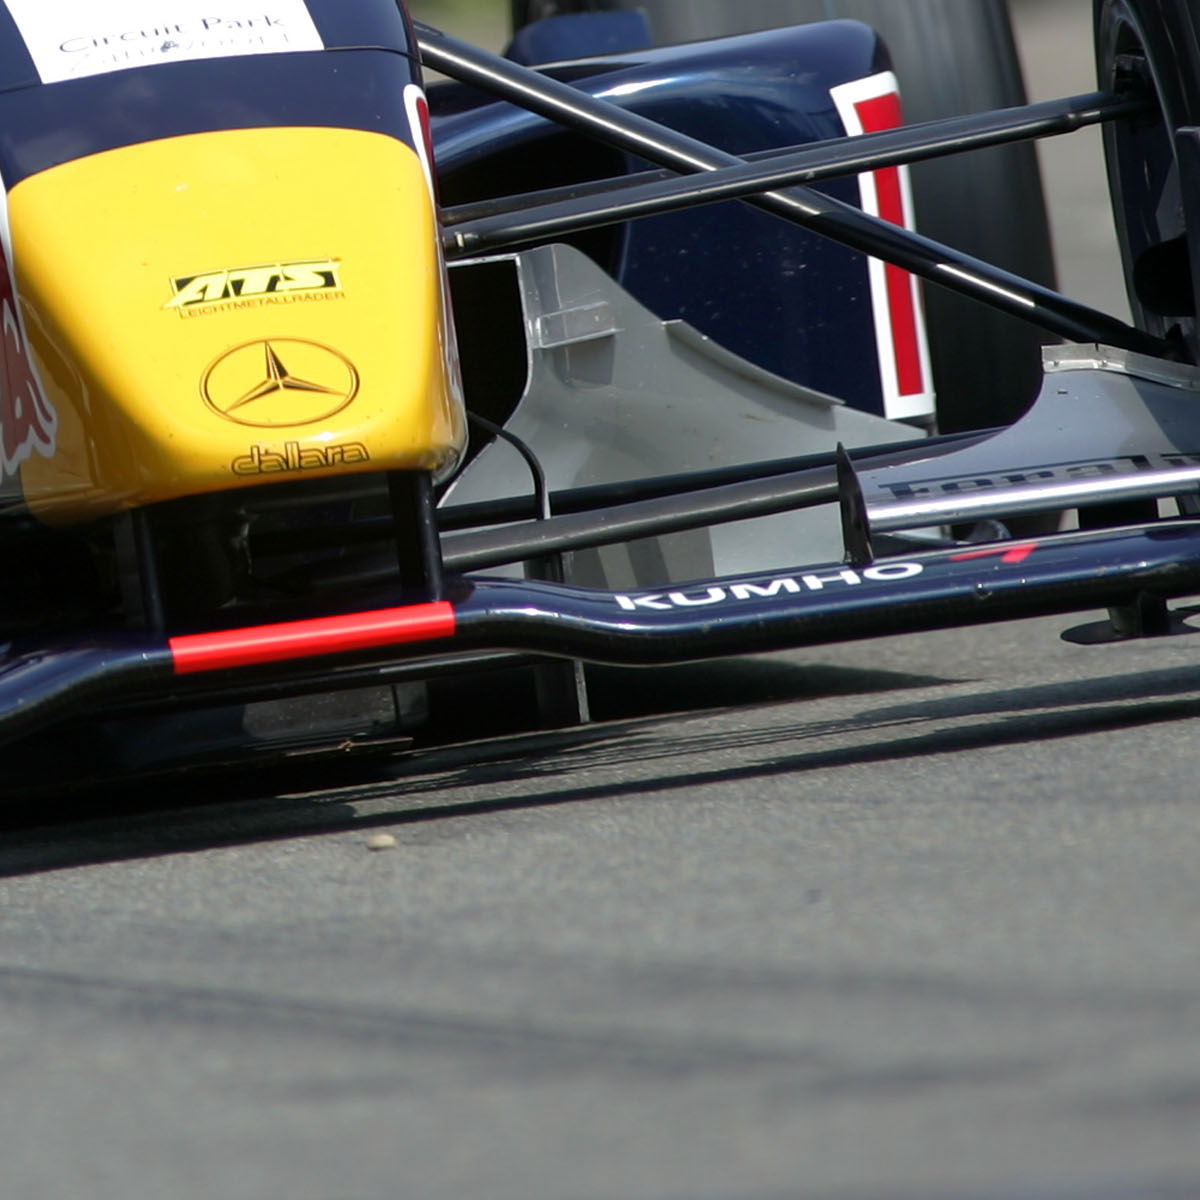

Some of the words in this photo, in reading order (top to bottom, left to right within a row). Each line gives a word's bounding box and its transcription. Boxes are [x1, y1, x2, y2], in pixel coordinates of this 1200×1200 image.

[58, 24, 183, 54] Circuit
[201, 14, 285, 31] Park
[166, 259, 342, 309] ATS
[231, 441, 371, 477] dallara
[614, 561, 924, 611] KUMHO
